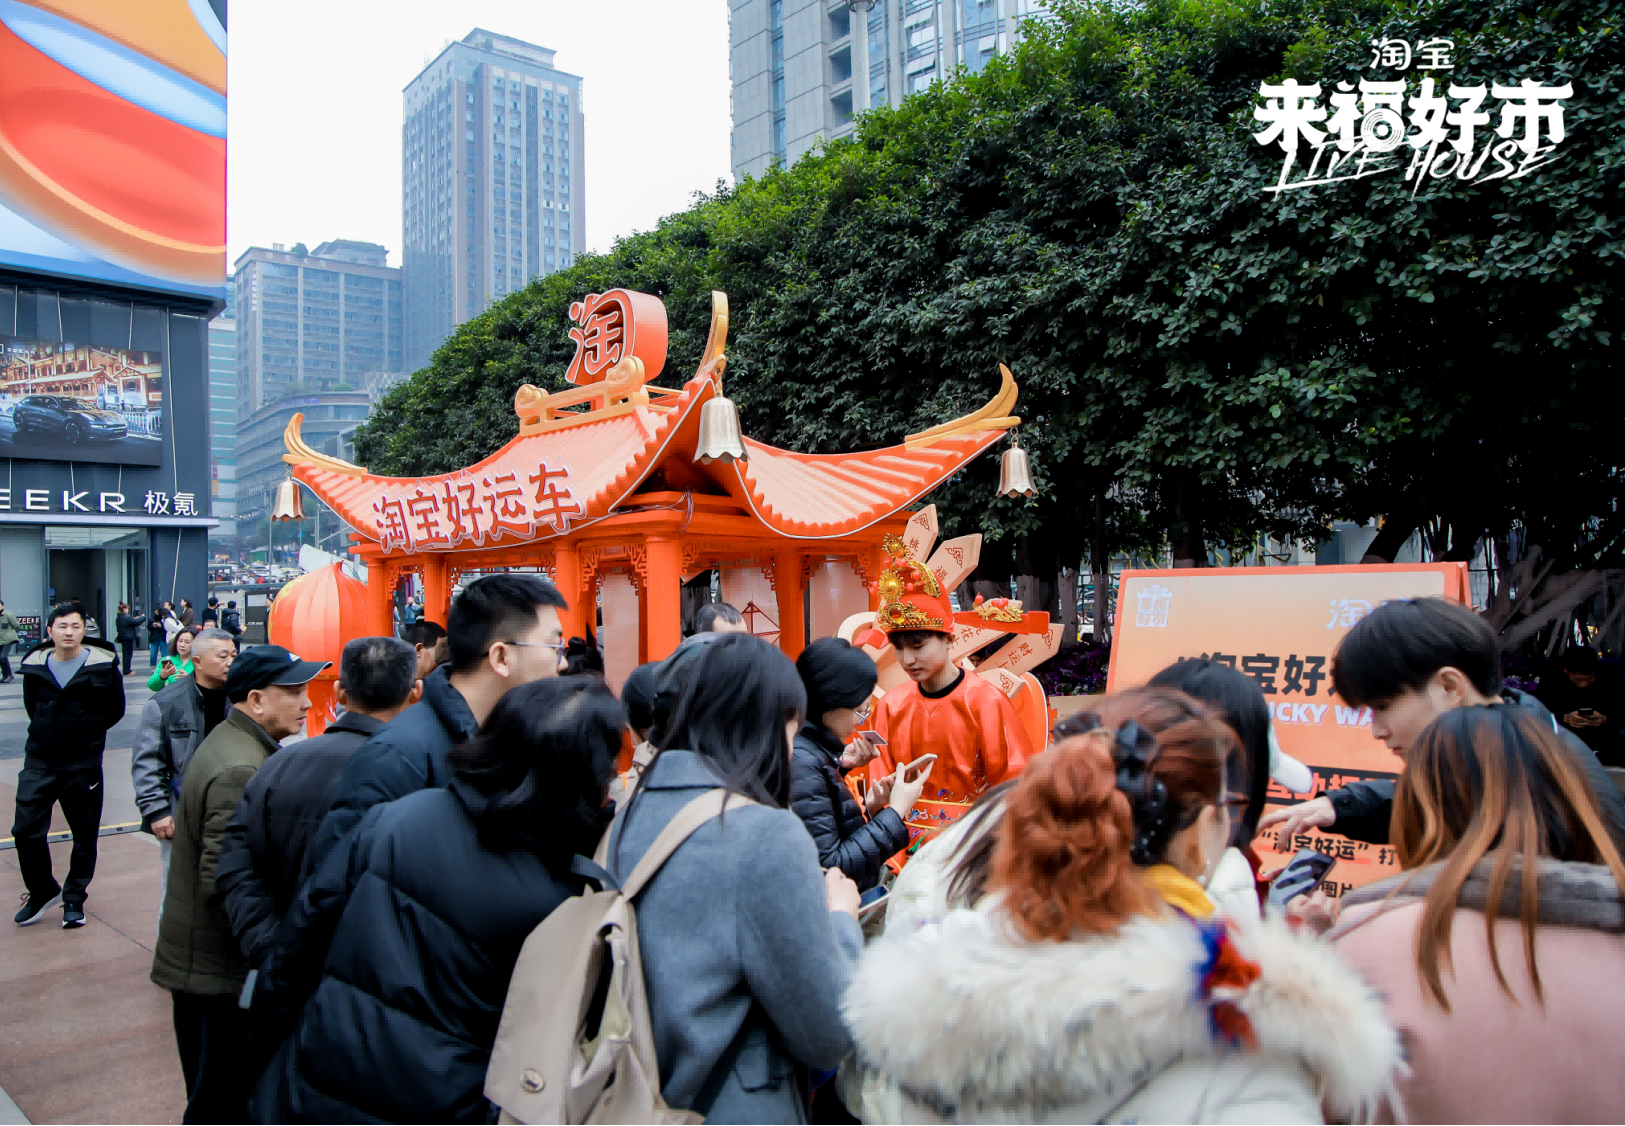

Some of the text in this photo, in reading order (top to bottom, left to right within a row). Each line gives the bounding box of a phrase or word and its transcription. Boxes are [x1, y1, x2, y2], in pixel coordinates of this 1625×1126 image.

[564, 288, 636, 384] 淘
[143, 490, 199, 517] 极氪
[371, 458, 585, 554] 淘宝好运车
[17, 616, 41, 625] ZEEKR
